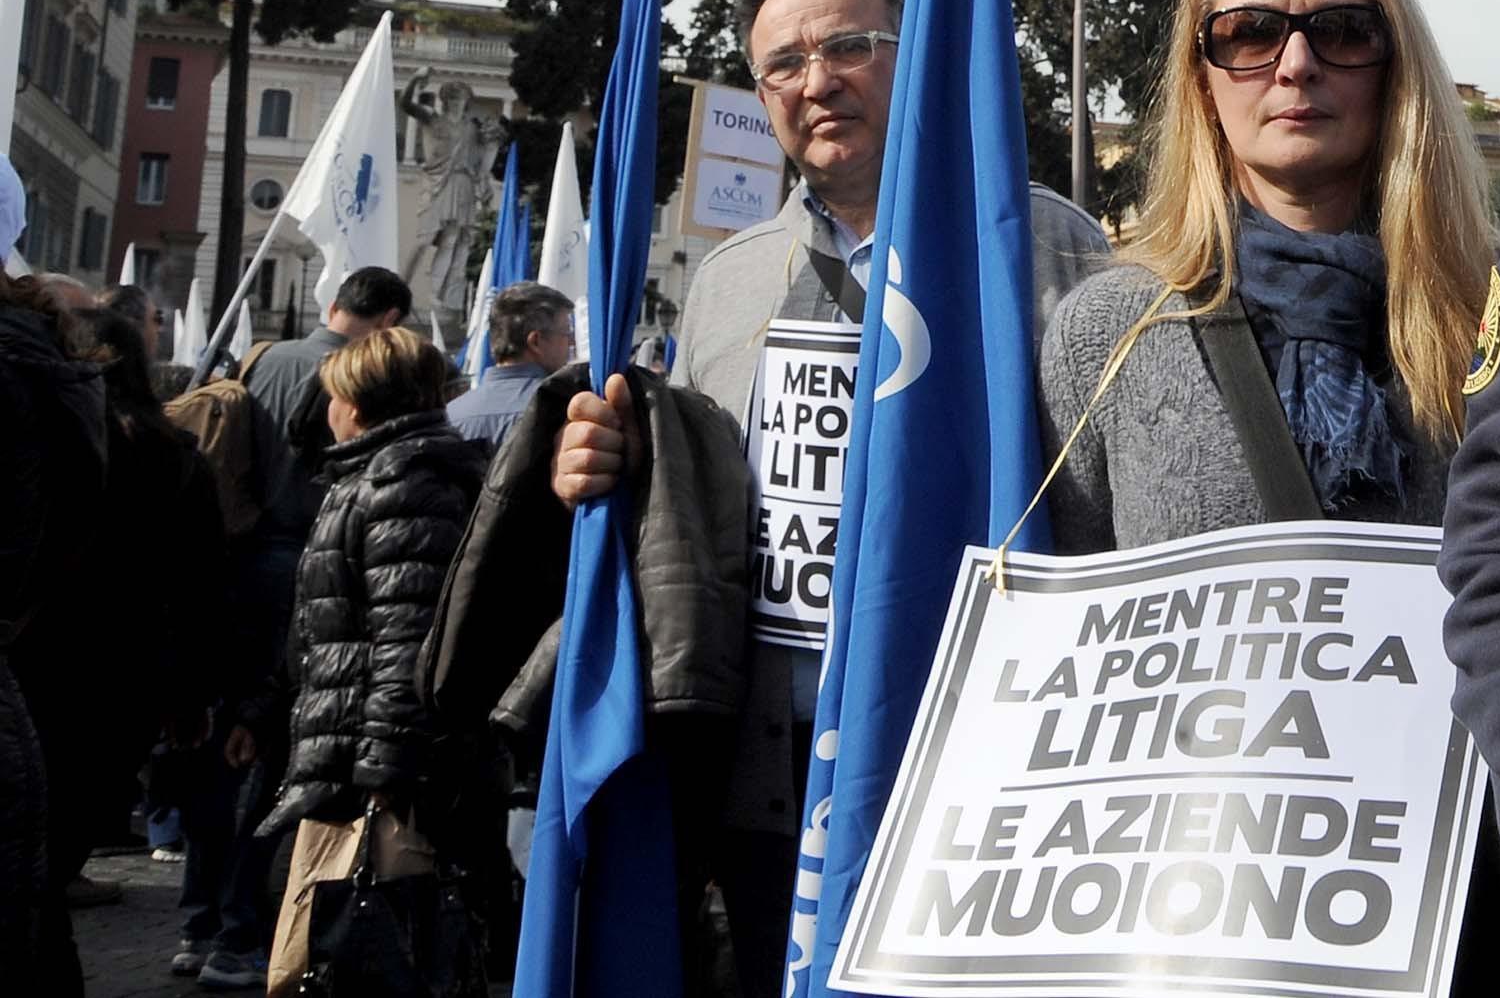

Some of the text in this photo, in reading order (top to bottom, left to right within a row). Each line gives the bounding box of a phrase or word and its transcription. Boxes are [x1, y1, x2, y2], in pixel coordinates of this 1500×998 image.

[711, 186, 762, 205] ASCOM
[783, 361, 858, 399] MEN
[760, 398, 786, 434] LA
[769, 440, 848, 492] LIT
[1076, 577, 1350, 647] MENTRE
[993, 632, 1419, 702] LA POLITICA
[1026, 689, 1331, 772] LITIGA
[931, 792, 1408, 864] LE AZIENDE
[905, 860, 1393, 946] MUOIONO
